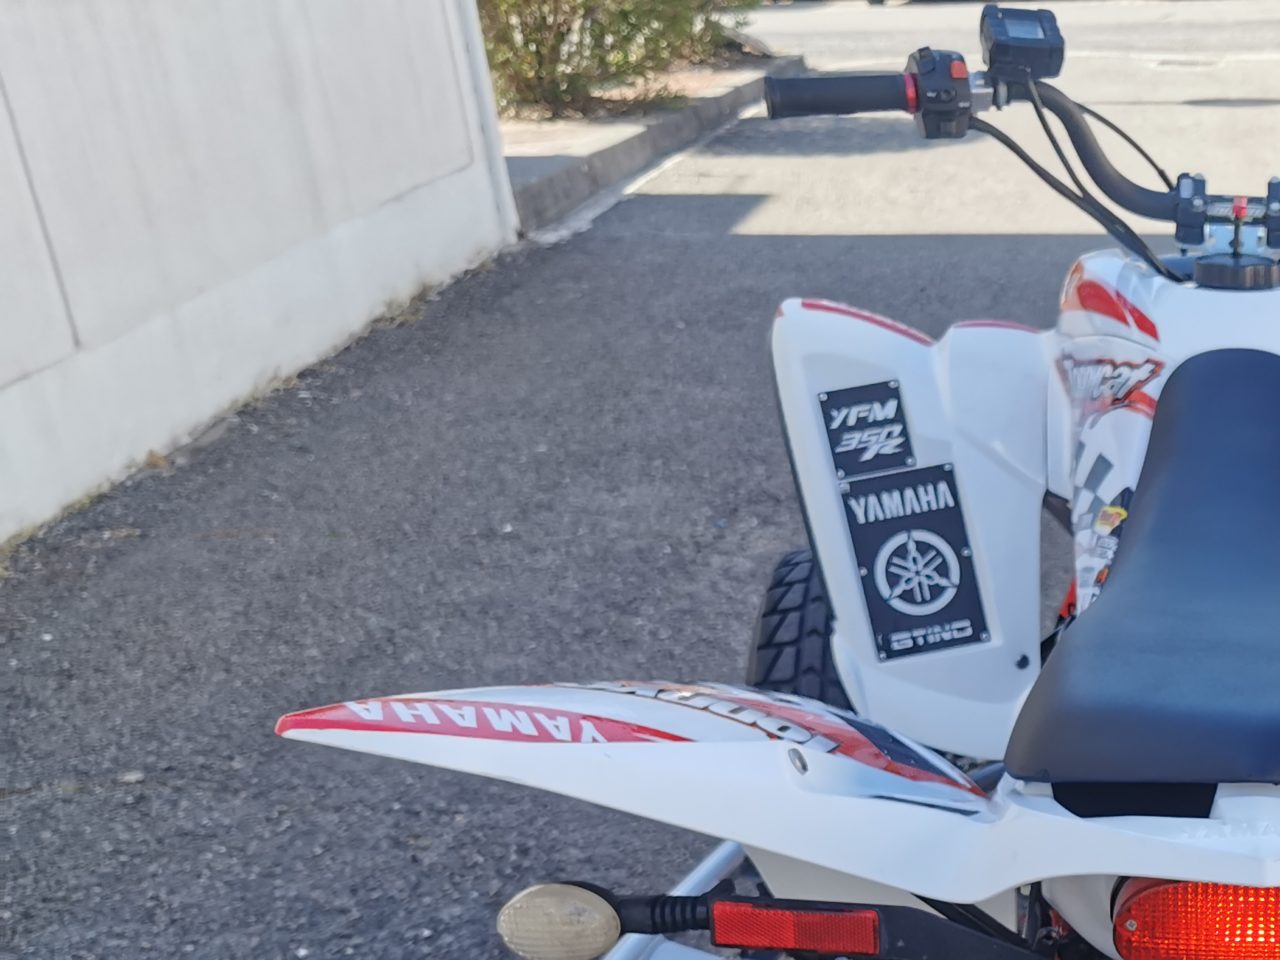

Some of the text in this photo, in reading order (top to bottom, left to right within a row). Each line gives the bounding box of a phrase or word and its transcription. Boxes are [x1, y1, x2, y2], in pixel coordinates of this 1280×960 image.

[829, 398, 898, 429] YFM
[849, 480, 955, 524] YAMAHA
[342, 701, 609, 743] YAMAHA
